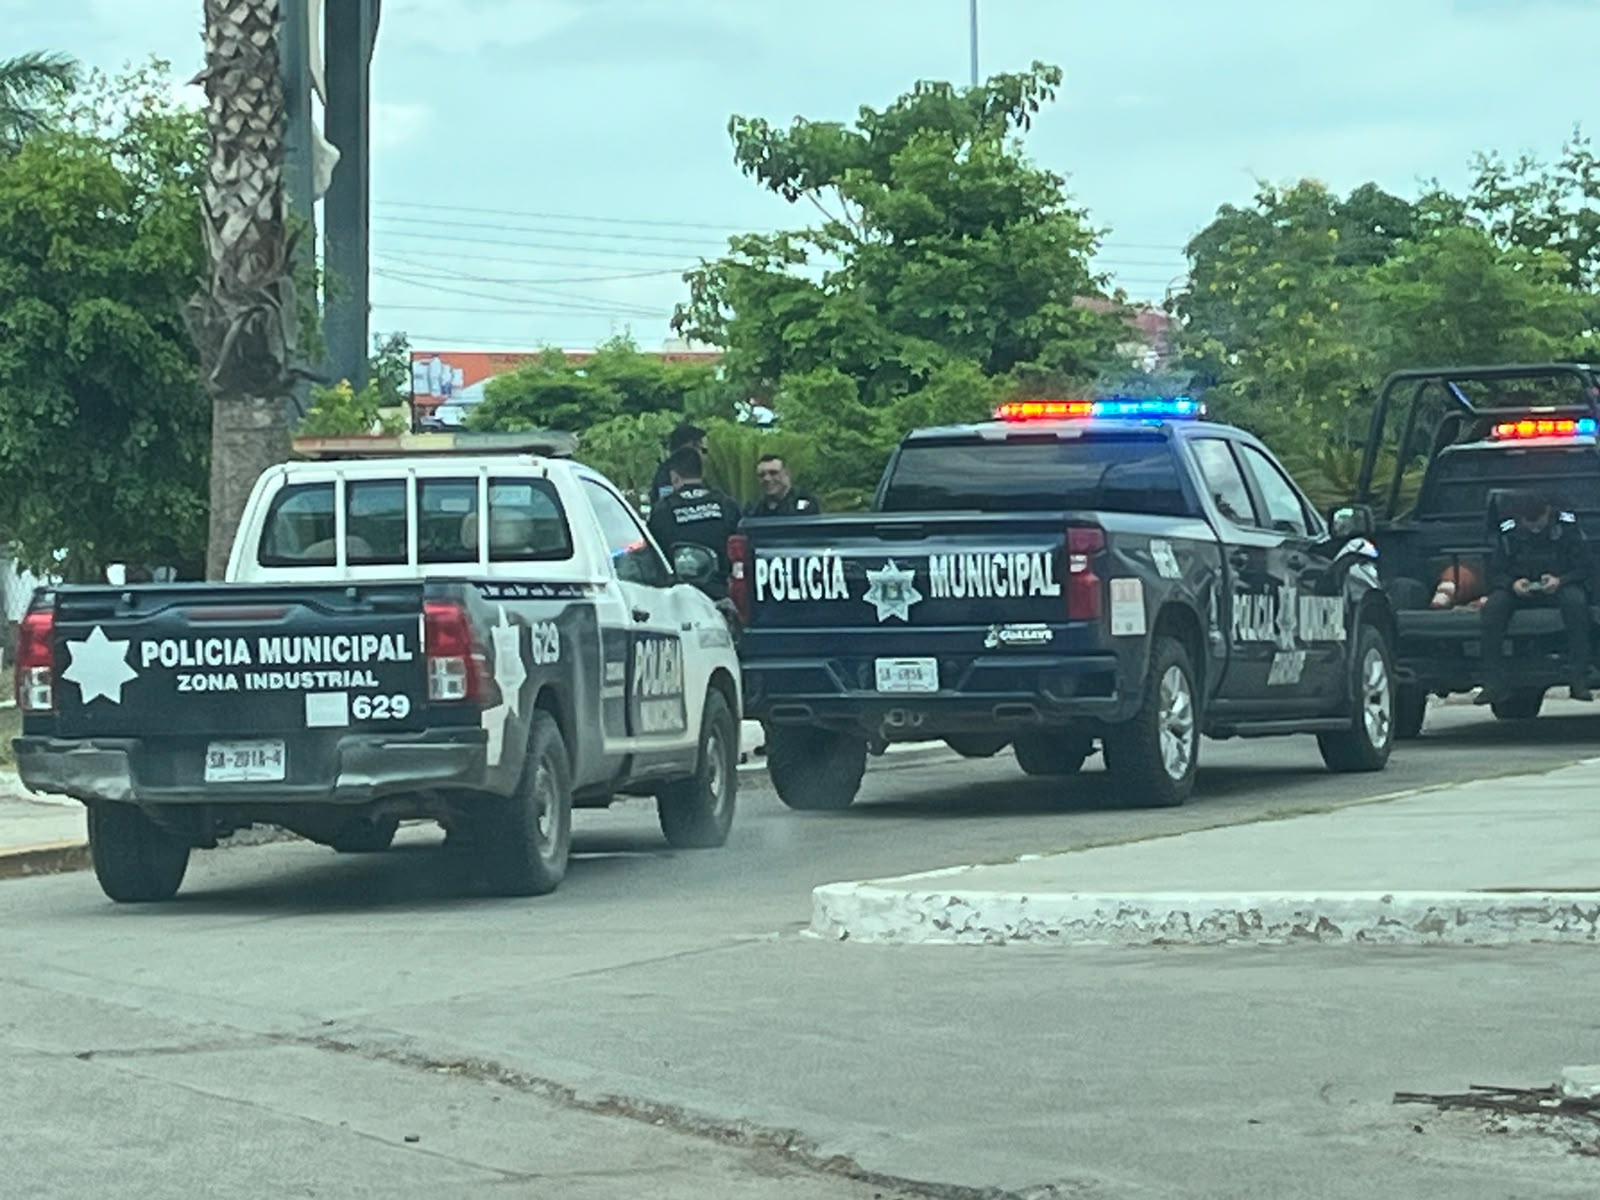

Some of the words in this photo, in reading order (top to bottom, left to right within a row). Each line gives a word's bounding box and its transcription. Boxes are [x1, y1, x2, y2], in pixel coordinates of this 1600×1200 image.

[928, 552, 1061, 598] MUNICIPAL
[141, 638, 251, 667] POLICIA
[259, 634, 412, 664] MUNICIPAL
[531, 621, 560, 666] 629
[177, 672, 239, 691] ZONA
[245, 670, 379, 689] INDUSTRIAL
[352, 694, 410, 719] 629
